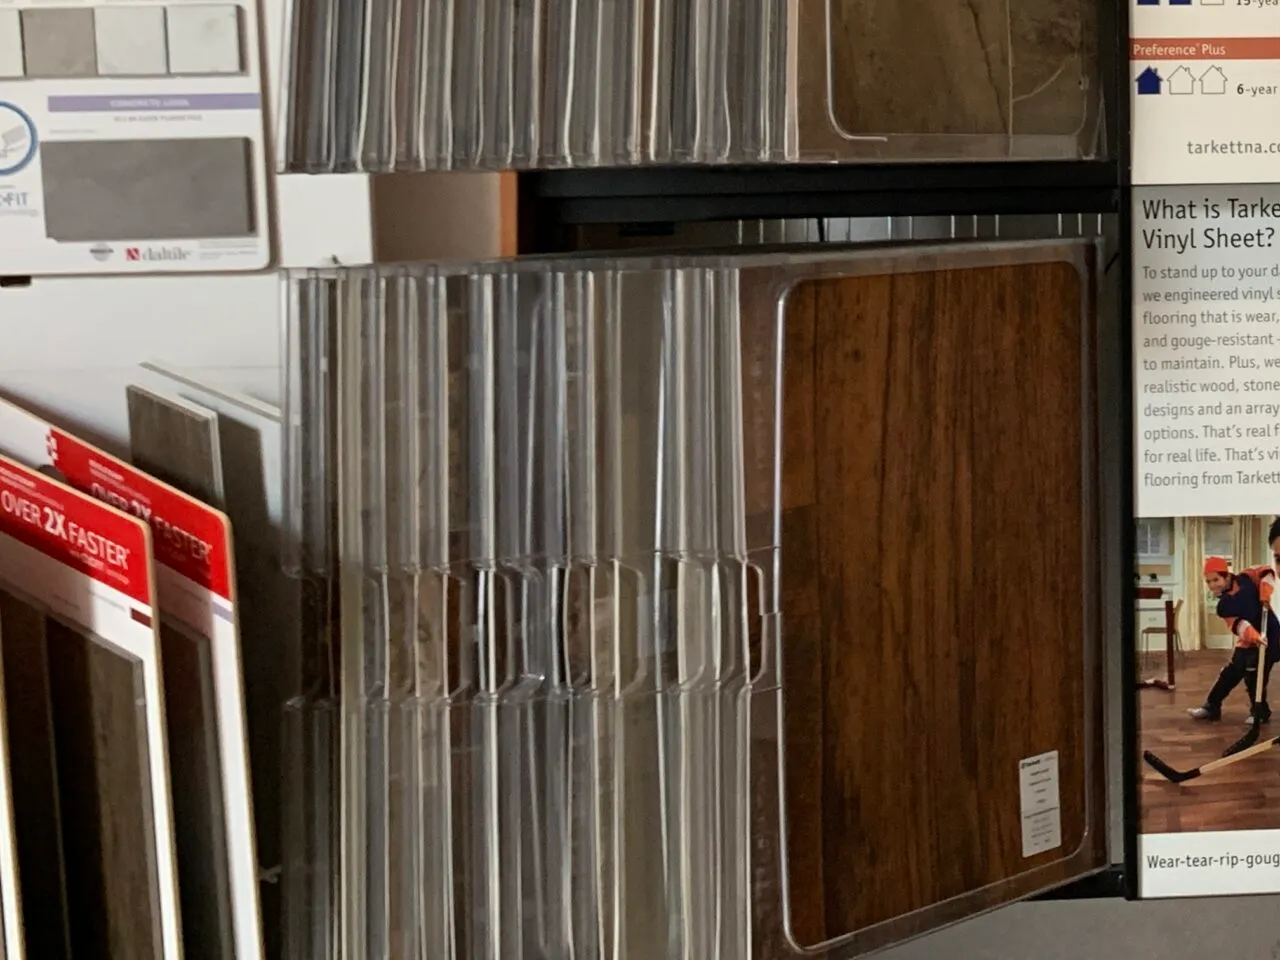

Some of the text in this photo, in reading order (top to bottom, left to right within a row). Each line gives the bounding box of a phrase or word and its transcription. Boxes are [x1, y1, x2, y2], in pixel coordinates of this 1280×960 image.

[1201, 43, 1226, 56] Plus
[1236, 83, 1278, 96] 6-year
[1142, 199, 1197, 220] What
[1204, 199, 1220, 218] is
[1142, 227, 1275, 254] Vinyl Sheet?
[1142, 265, 1157, 280] To
[1160, 264, 1198, 279] stand
[1201, 267, 1218, 283] up
[1221, 265, 1235, 279] to
[1238, 265, 1268, 281] your
[1142, 290, 1161, 303] we
[1164, 286, 1239, 304] engineered
[1242, 286, 1274, 303] vinyl
[1143, 310, 1197, 327] flooring
[1200, 310, 1228, 324] that
[1231, 309, 1242, 323] is
[1245, 309, 1280, 326] wear,
[1143, 334, 1168, 348] and
[1171, 332, 1274, 350] gouge-resistant
[1143, 357, 1158, 371] to
[1160, 356, 1225, 370] maintain.
[1228, 355, 1261, 371] Plus,
[1143, 379, 1197, 394] realistic
[1199, 379, 1240, 395] wood,
[1243, 378, 1280, 392] stone
[1143, 402, 1195, 420] designs
[1197, 402, 1222, 416] and
[1225, 403, 1242, 415] an
[1245, 402, 1280, 417] array
[1143, 425, 1199, 442] options.
[1202, 424, 1243, 439] That's
[1245, 424, 1271, 438] real
[1143, 448, 1165, 463] for
[1167, 448, 1192, 463] real
[1195, 448, 1221, 462] life.
[1224, 447, 1265, 462] That's
[1144, 472, 1199, 489] flooring
[1202, 471, 1233, 485] from
[1, 491, 43, 528] OVER
[43, 506, 68, 540] 2X
